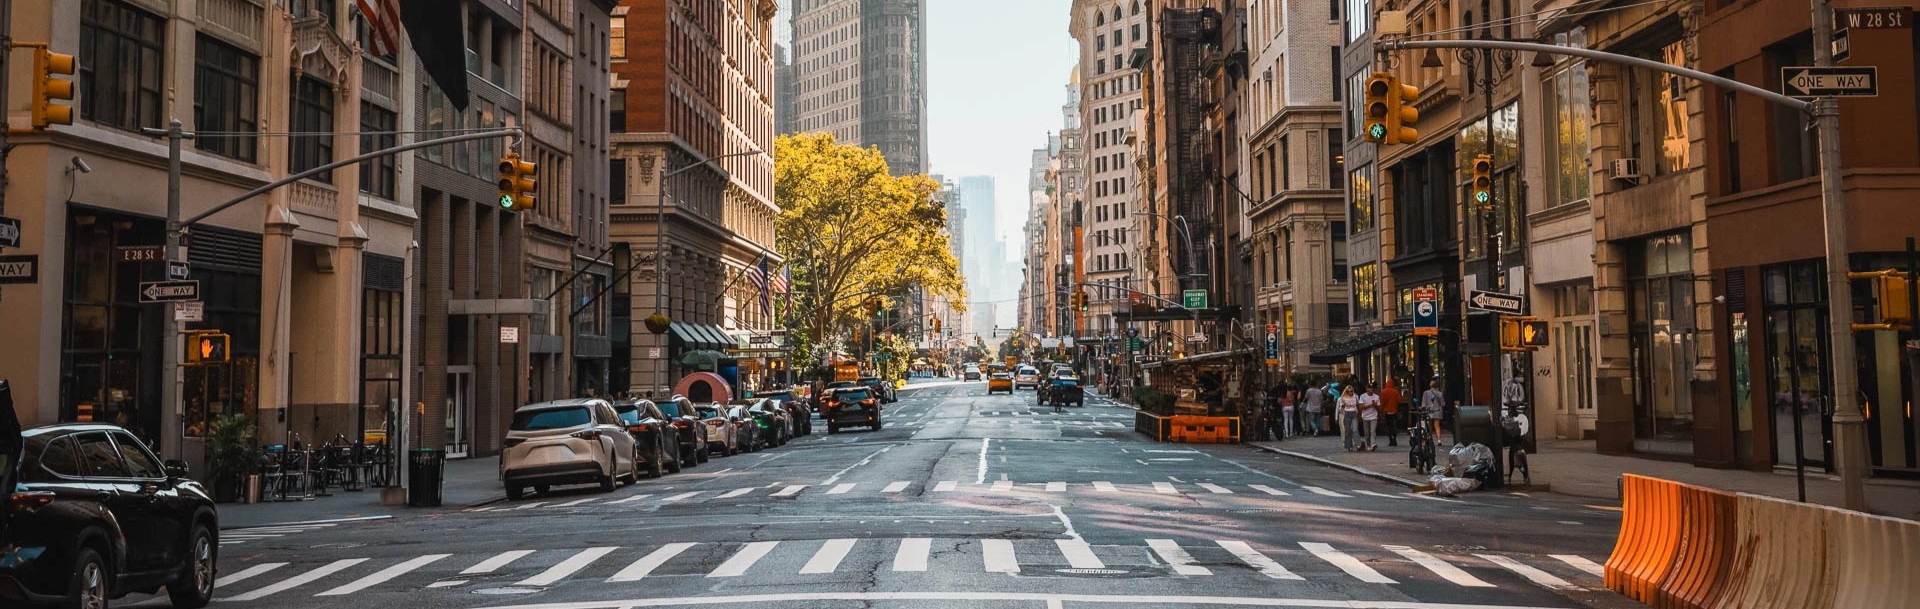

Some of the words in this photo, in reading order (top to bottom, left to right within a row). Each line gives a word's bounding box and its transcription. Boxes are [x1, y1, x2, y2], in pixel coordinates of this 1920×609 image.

[1849, 13, 1860, 28] W
[1867, 13, 1882, 27] 28
[1889, 12, 1902, 26] St
[1797, 76, 1824, 88] ONE
[1836, 76, 1864, 88] WAY
[125, 251, 130, 260] E
[132, 250, 142, 260] 28
[145, 249, 154, 260] St
[149, 288, 166, 297] ONE
[173, 286, 190, 295] WAY
[1478, 296, 1493, 305] ONE
[1500, 299, 1516, 309] WAY
